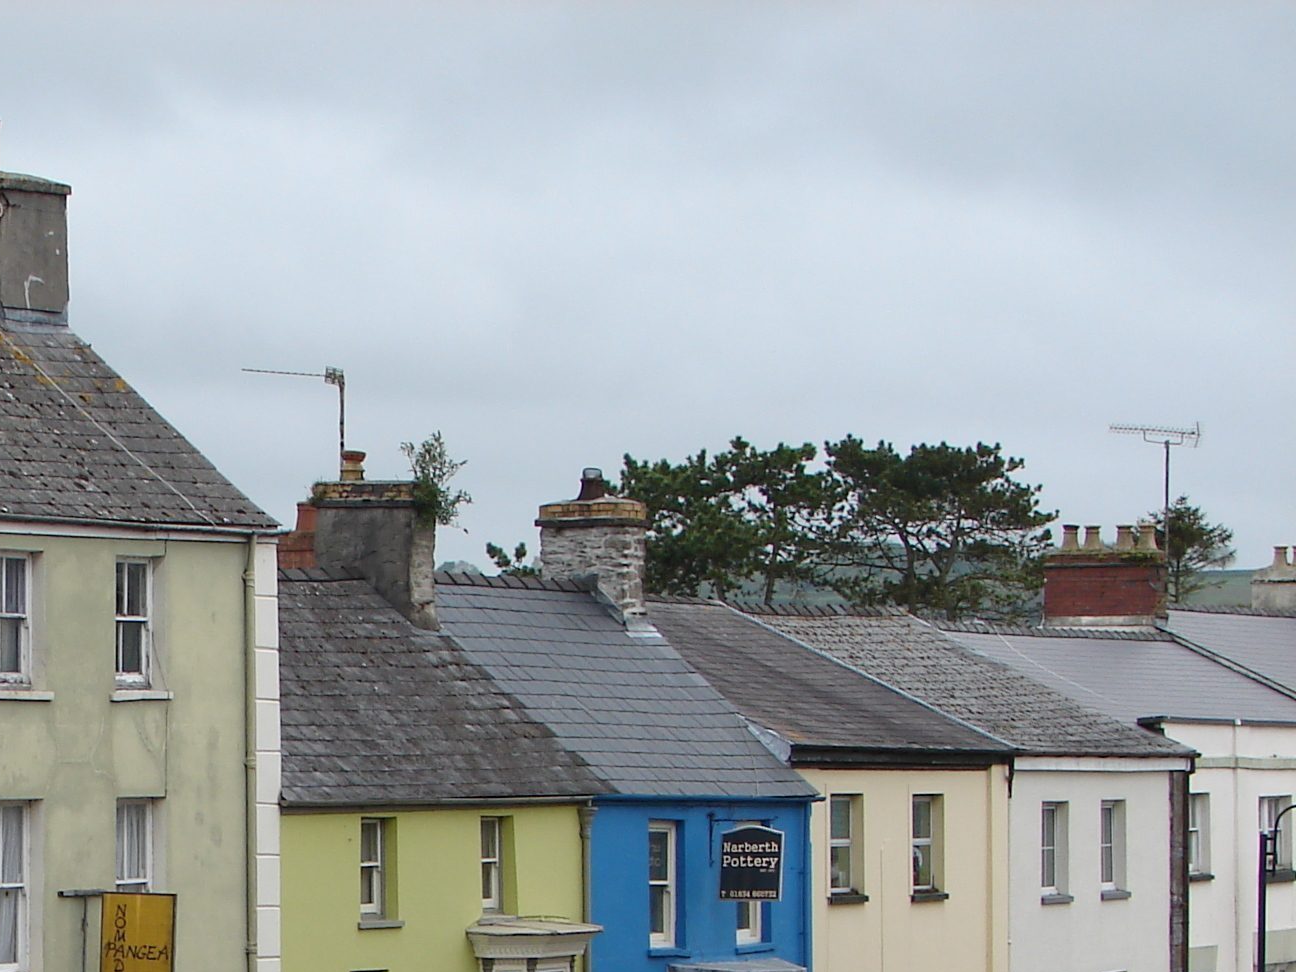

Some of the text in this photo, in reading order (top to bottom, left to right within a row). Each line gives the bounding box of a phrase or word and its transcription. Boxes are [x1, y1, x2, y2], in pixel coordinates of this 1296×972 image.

[723, 841, 778, 853] Narberth
[722, 855, 779, 869] Pottery
[104, 942, 169, 960] PANGEA
